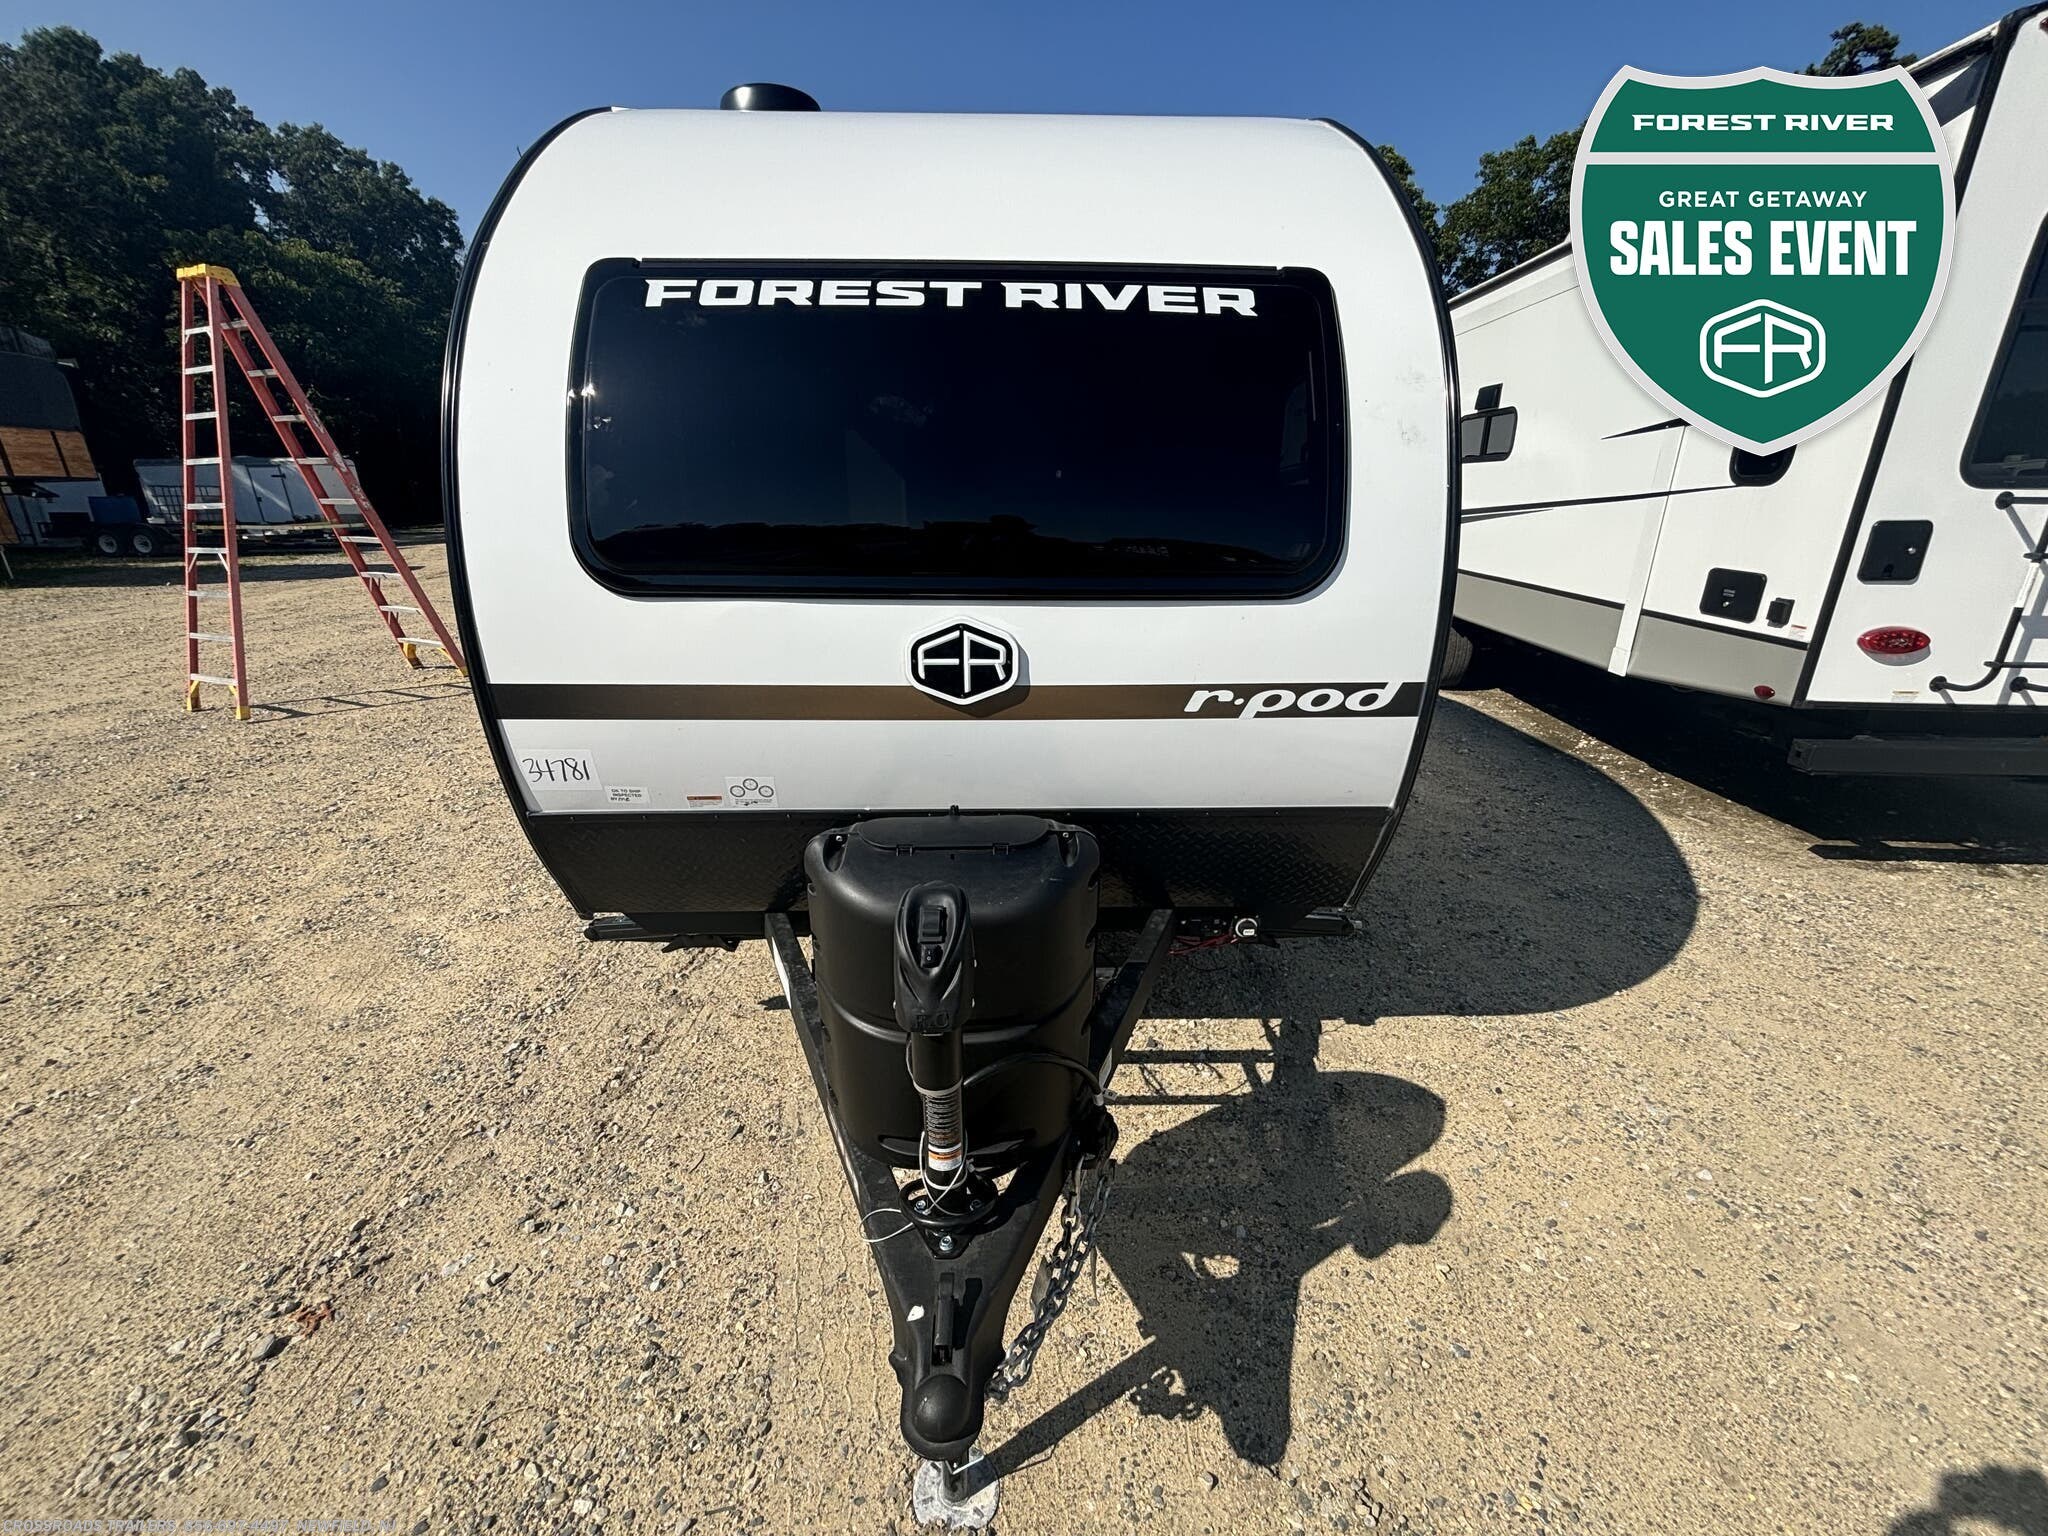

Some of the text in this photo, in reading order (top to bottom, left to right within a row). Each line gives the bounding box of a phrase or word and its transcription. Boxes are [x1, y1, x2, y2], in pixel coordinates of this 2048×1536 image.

[645, 279, 1258, 317] FOREST RIVER
[522, 757, 590, 783] 34781
